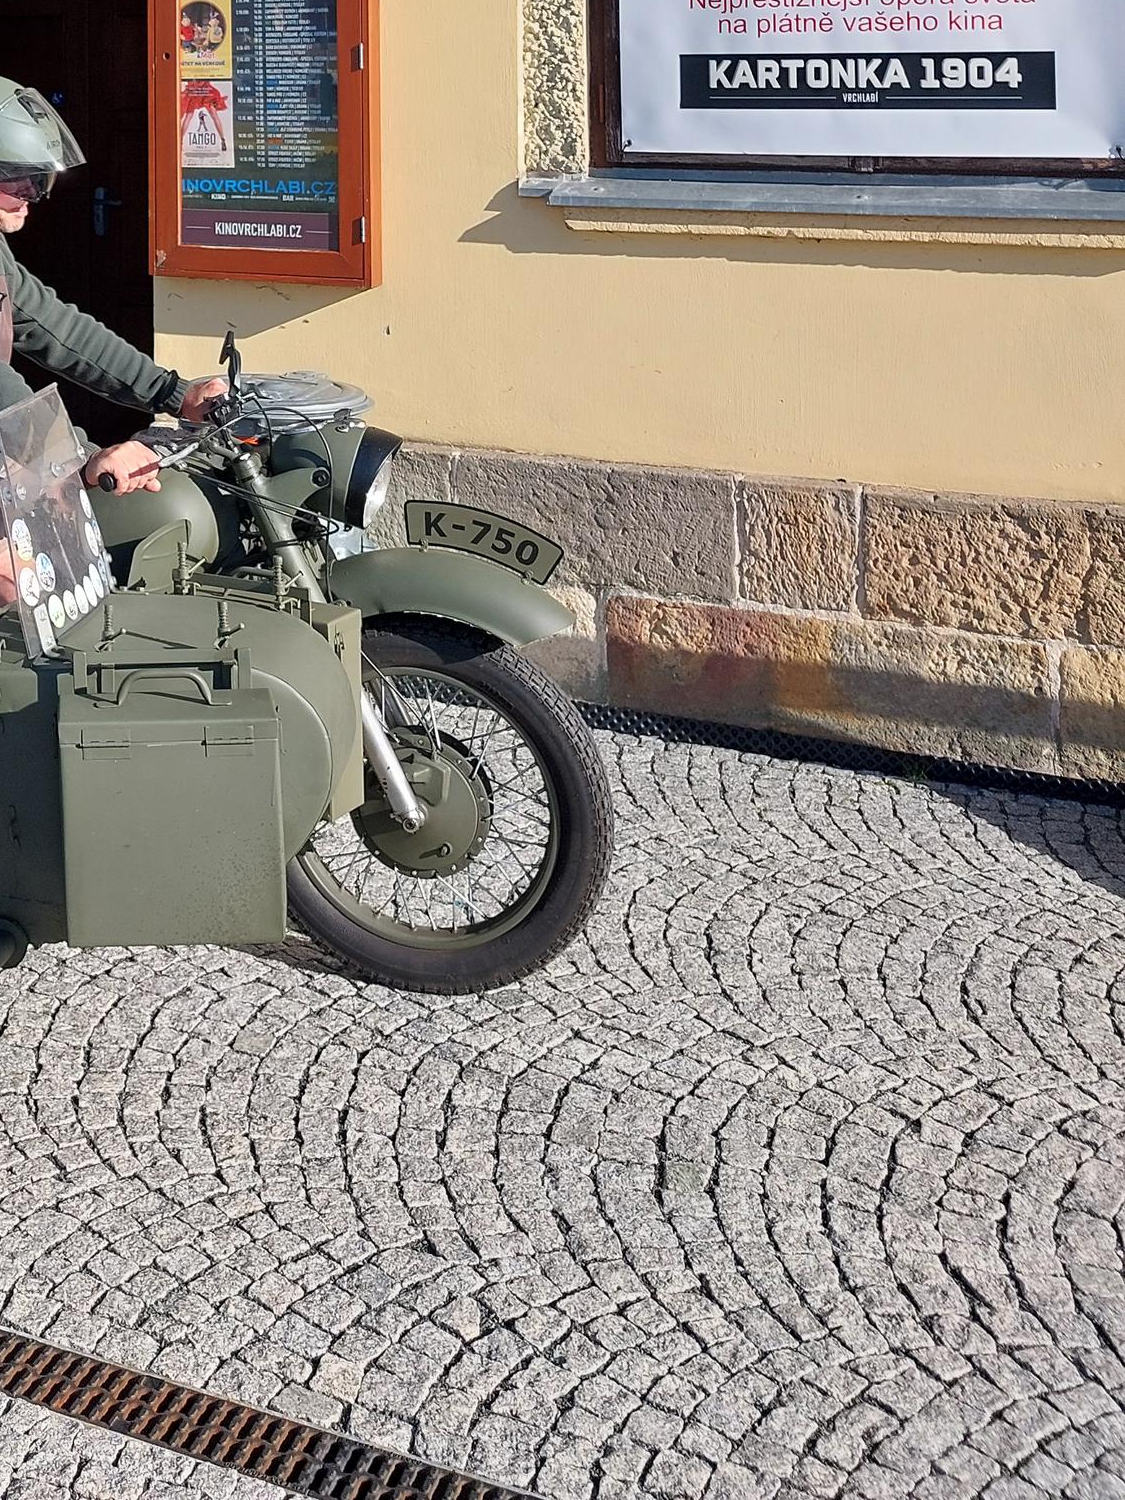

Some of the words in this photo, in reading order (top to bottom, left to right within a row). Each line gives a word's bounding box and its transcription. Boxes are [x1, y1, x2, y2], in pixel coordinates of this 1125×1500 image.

[718, 16, 747, 34] na
[756, 10, 834, 38] plátně
[843, 10, 939, 33] vašeho
[948, 9, 1003, 31] kina
[708, 58, 911, 90] KARTONKA
[919, 56, 1023, 89] 1904
[188, 132, 216, 145] TANGO
[181, 179, 336, 195] INOVRCHLABI.CZ
[215, 221, 303, 238] KINOVRCHLABI.CZ
[424, 511, 539, 566] K-750
